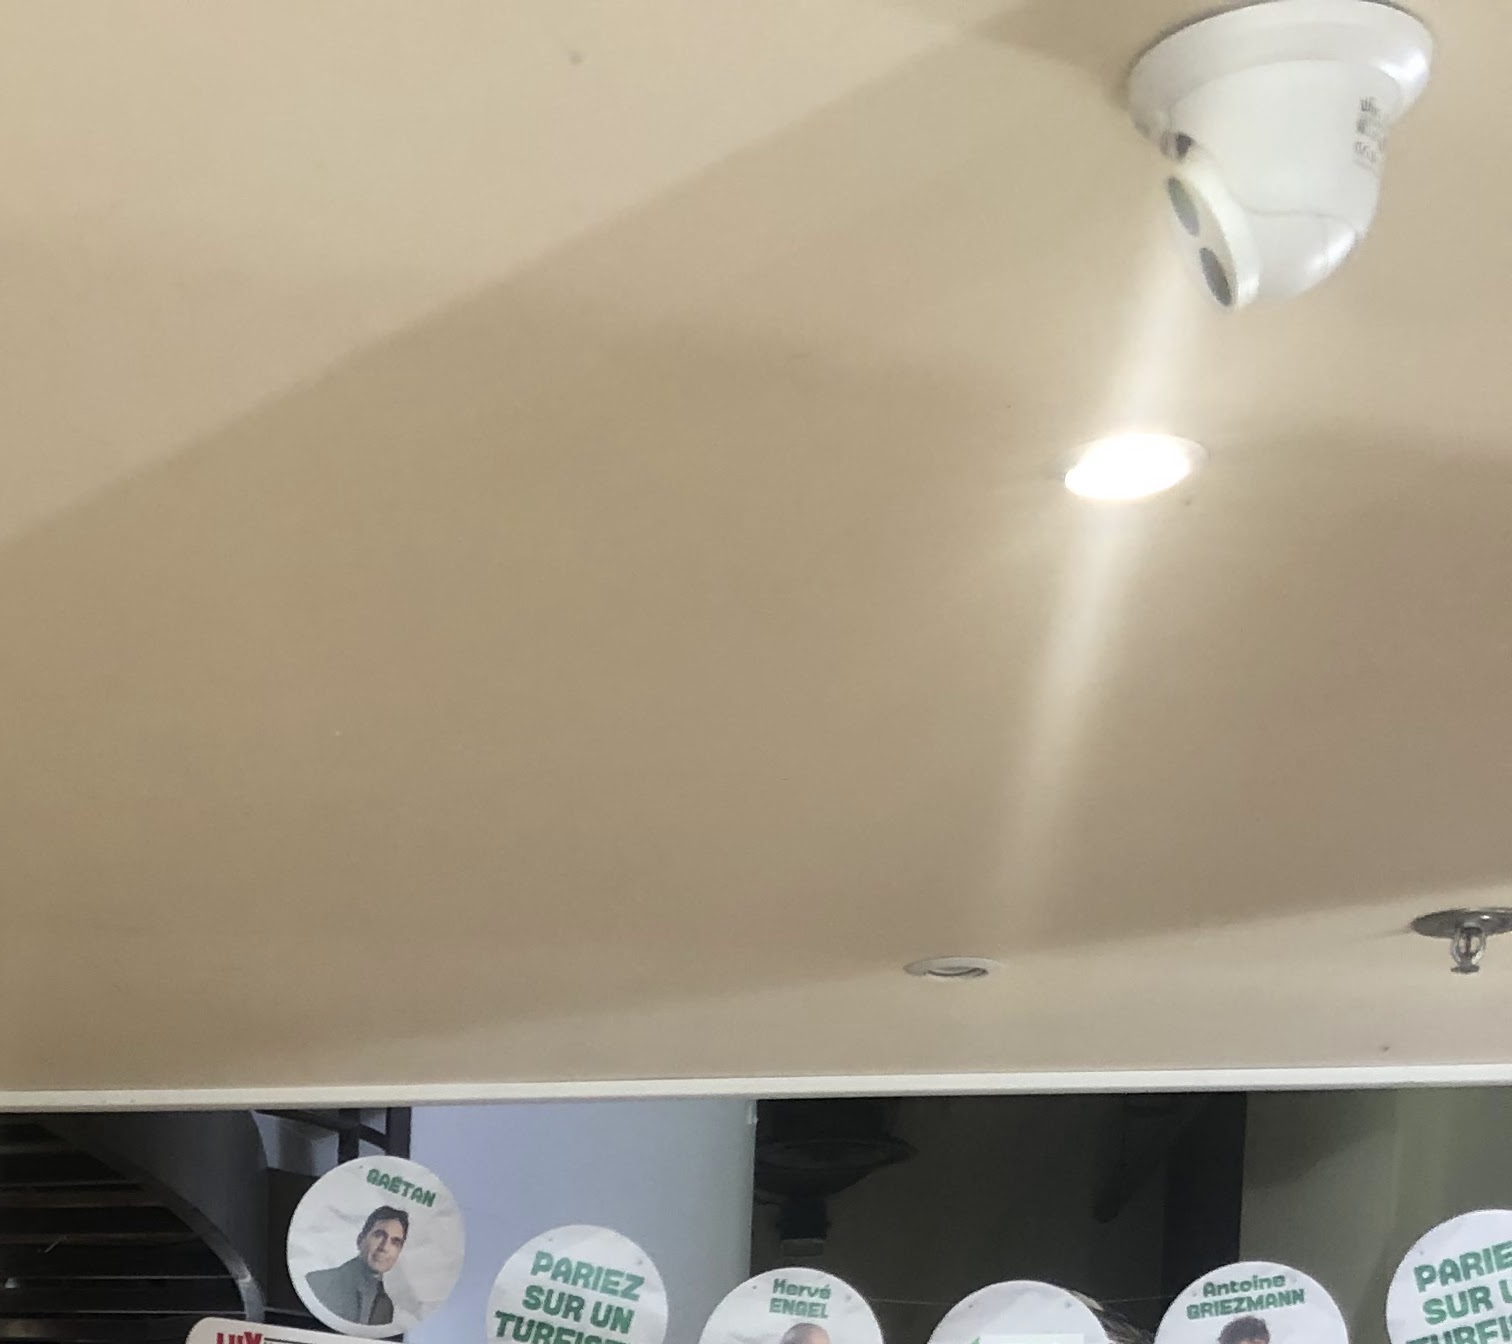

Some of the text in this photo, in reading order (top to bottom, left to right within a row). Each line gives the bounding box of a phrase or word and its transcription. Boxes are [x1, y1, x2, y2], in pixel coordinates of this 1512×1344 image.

[530, 1251, 644, 1300] PARIEZ
[1413, 1240, 1512, 1292] PARIE
[773, 1278, 831, 1300] Hervé
[1203, 1275, 1285, 1298] Antoine
[522, 1285, 634, 1333] SUR UN
[769, 1297, 828, 1318] ENGEL
[1186, 1289, 1305, 1320] GRIEZMANN
[1423, 1287, 1493, 1325] SUR
